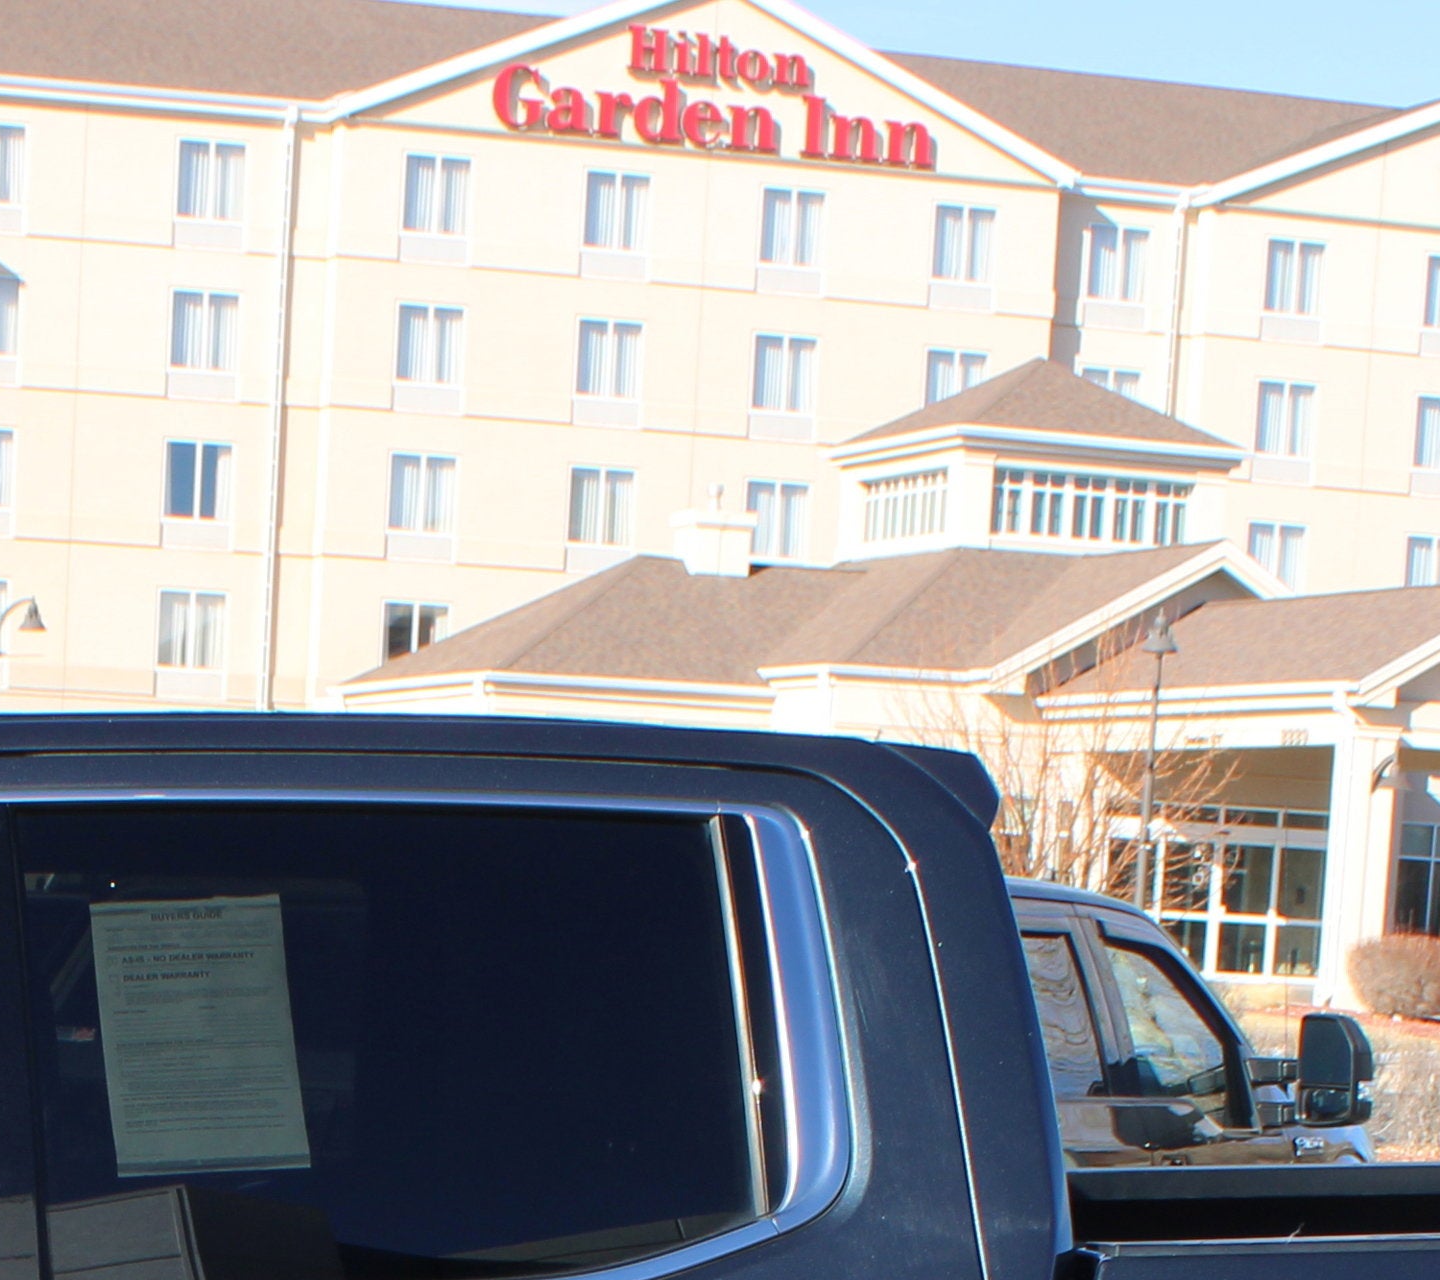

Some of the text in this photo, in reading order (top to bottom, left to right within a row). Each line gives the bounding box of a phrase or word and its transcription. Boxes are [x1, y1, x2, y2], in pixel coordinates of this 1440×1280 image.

[628, 24, 810, 88] Hilton
[492, 63, 935, 169] Garden Inn
[150, 910, 223, 922] BUYERS GUIDE
[153, 954, 167, 963] NO
[169, 952, 204, 962] DEALER
[206, 951, 255, 961] WARRANTY
[123, 970, 211, 982] DEALER WARRANTY
